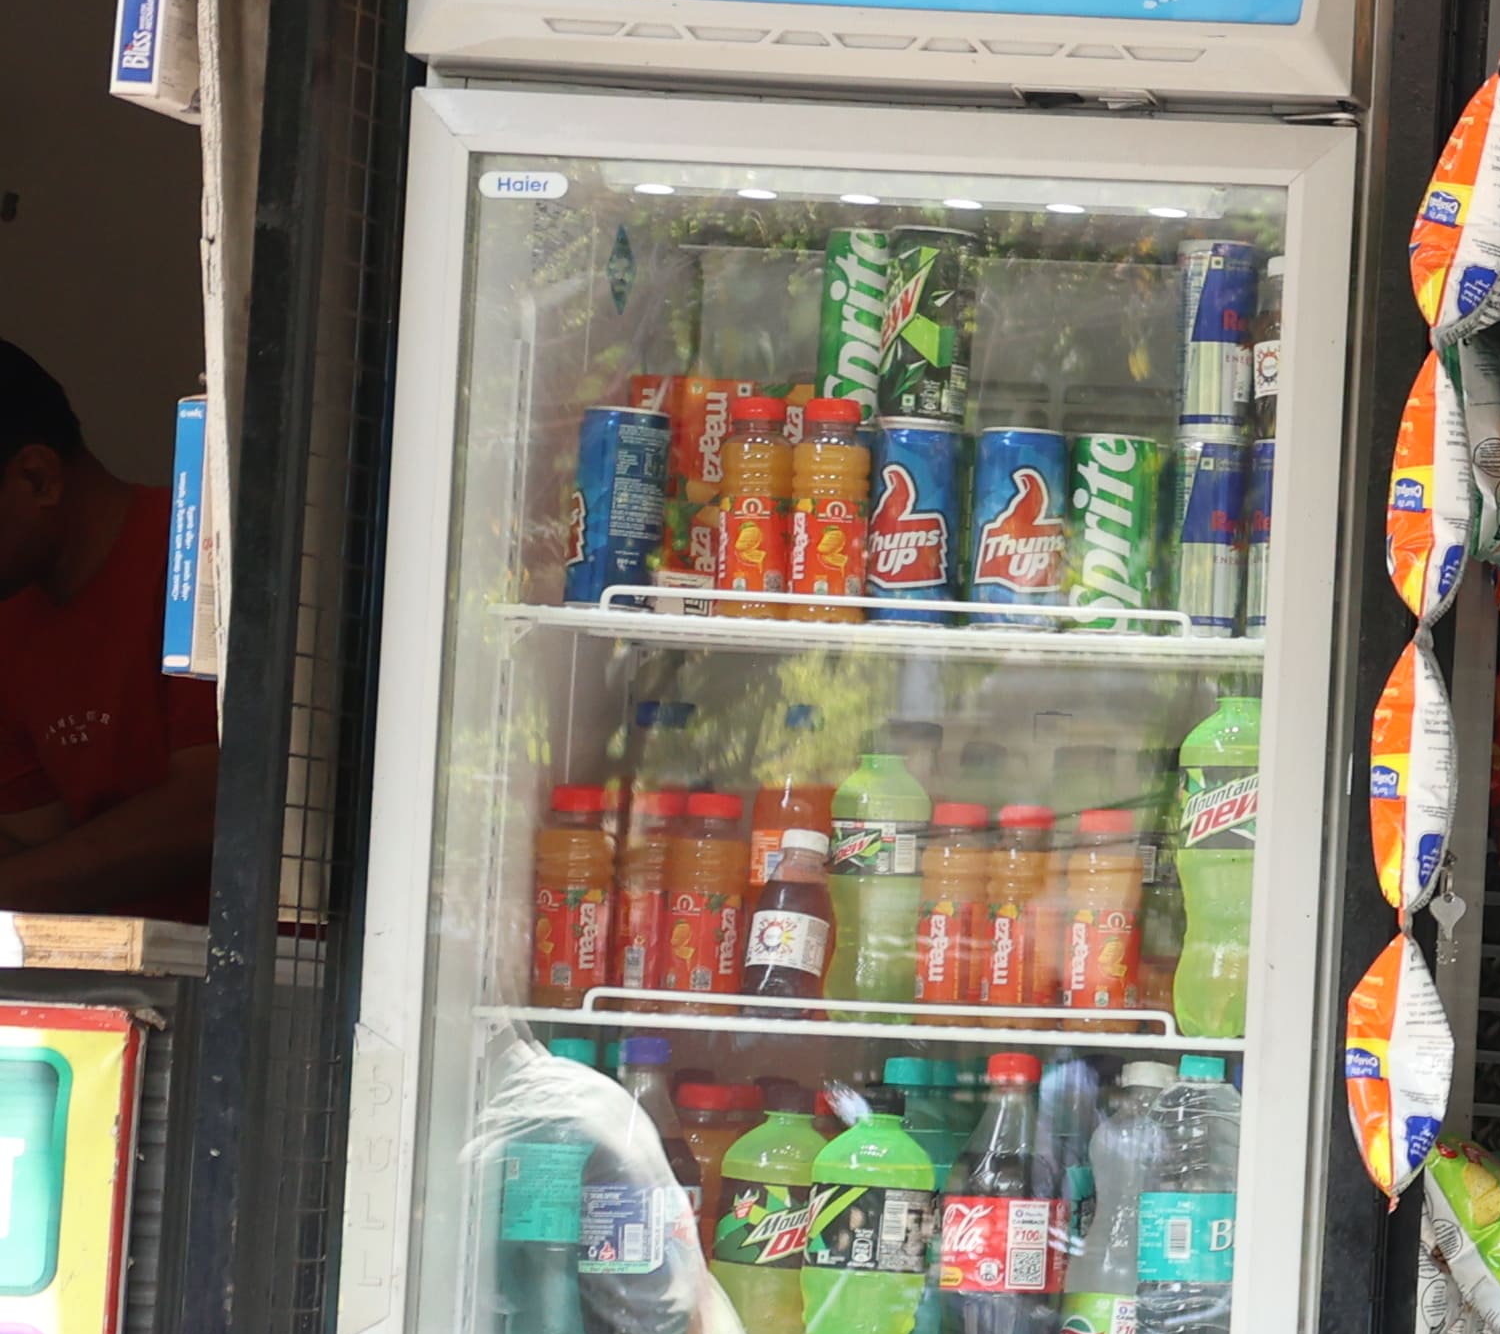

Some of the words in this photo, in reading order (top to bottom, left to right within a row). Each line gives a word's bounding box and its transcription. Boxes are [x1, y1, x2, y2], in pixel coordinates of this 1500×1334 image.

[121, 29, 152, 70] Bliss
[497, 175, 548, 193] Haier
[877, 550, 918, 574] UP
[1008, 553, 1050, 578] UP
[1070, 433, 1142, 632] Sprite
[578, 901, 597, 970] maaza
[718, 907, 737, 975] maaza
[928, 913, 947, 983] maaza
[992, 917, 1010, 985] maaza
